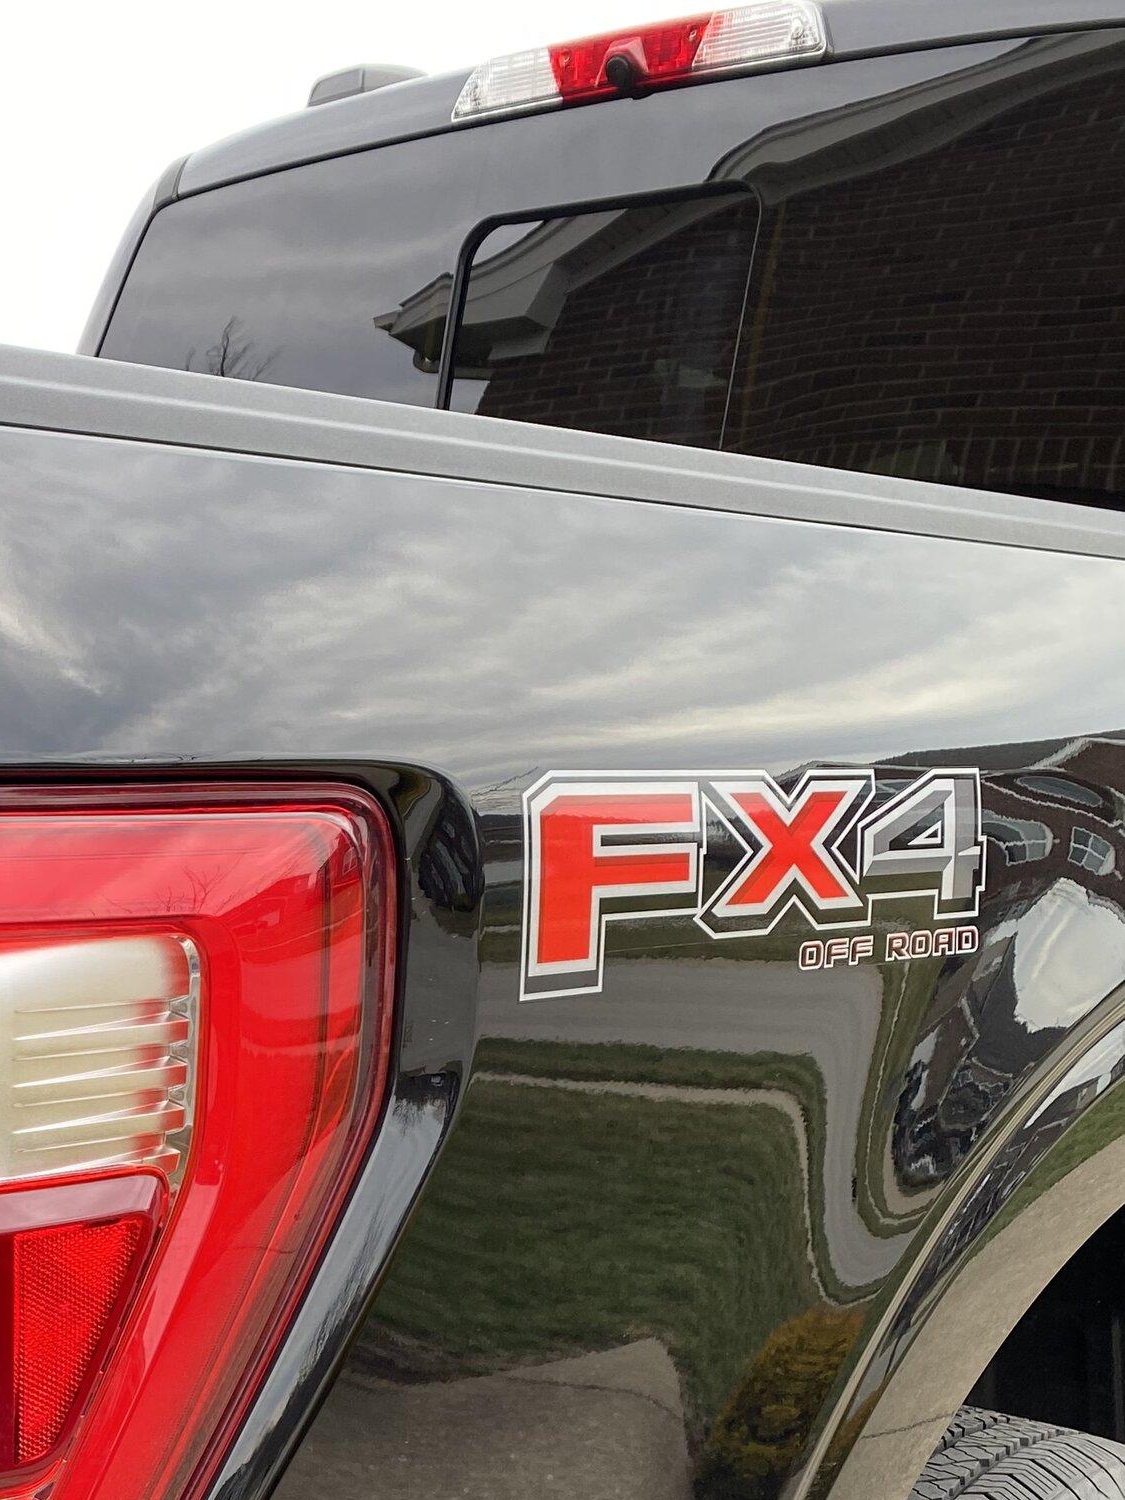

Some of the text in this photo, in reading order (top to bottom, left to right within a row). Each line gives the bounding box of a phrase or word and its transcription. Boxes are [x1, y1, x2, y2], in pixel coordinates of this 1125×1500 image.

[520, 768, 987, 1002] FX4
[798, 925, 979, 970] OFF ROAD
